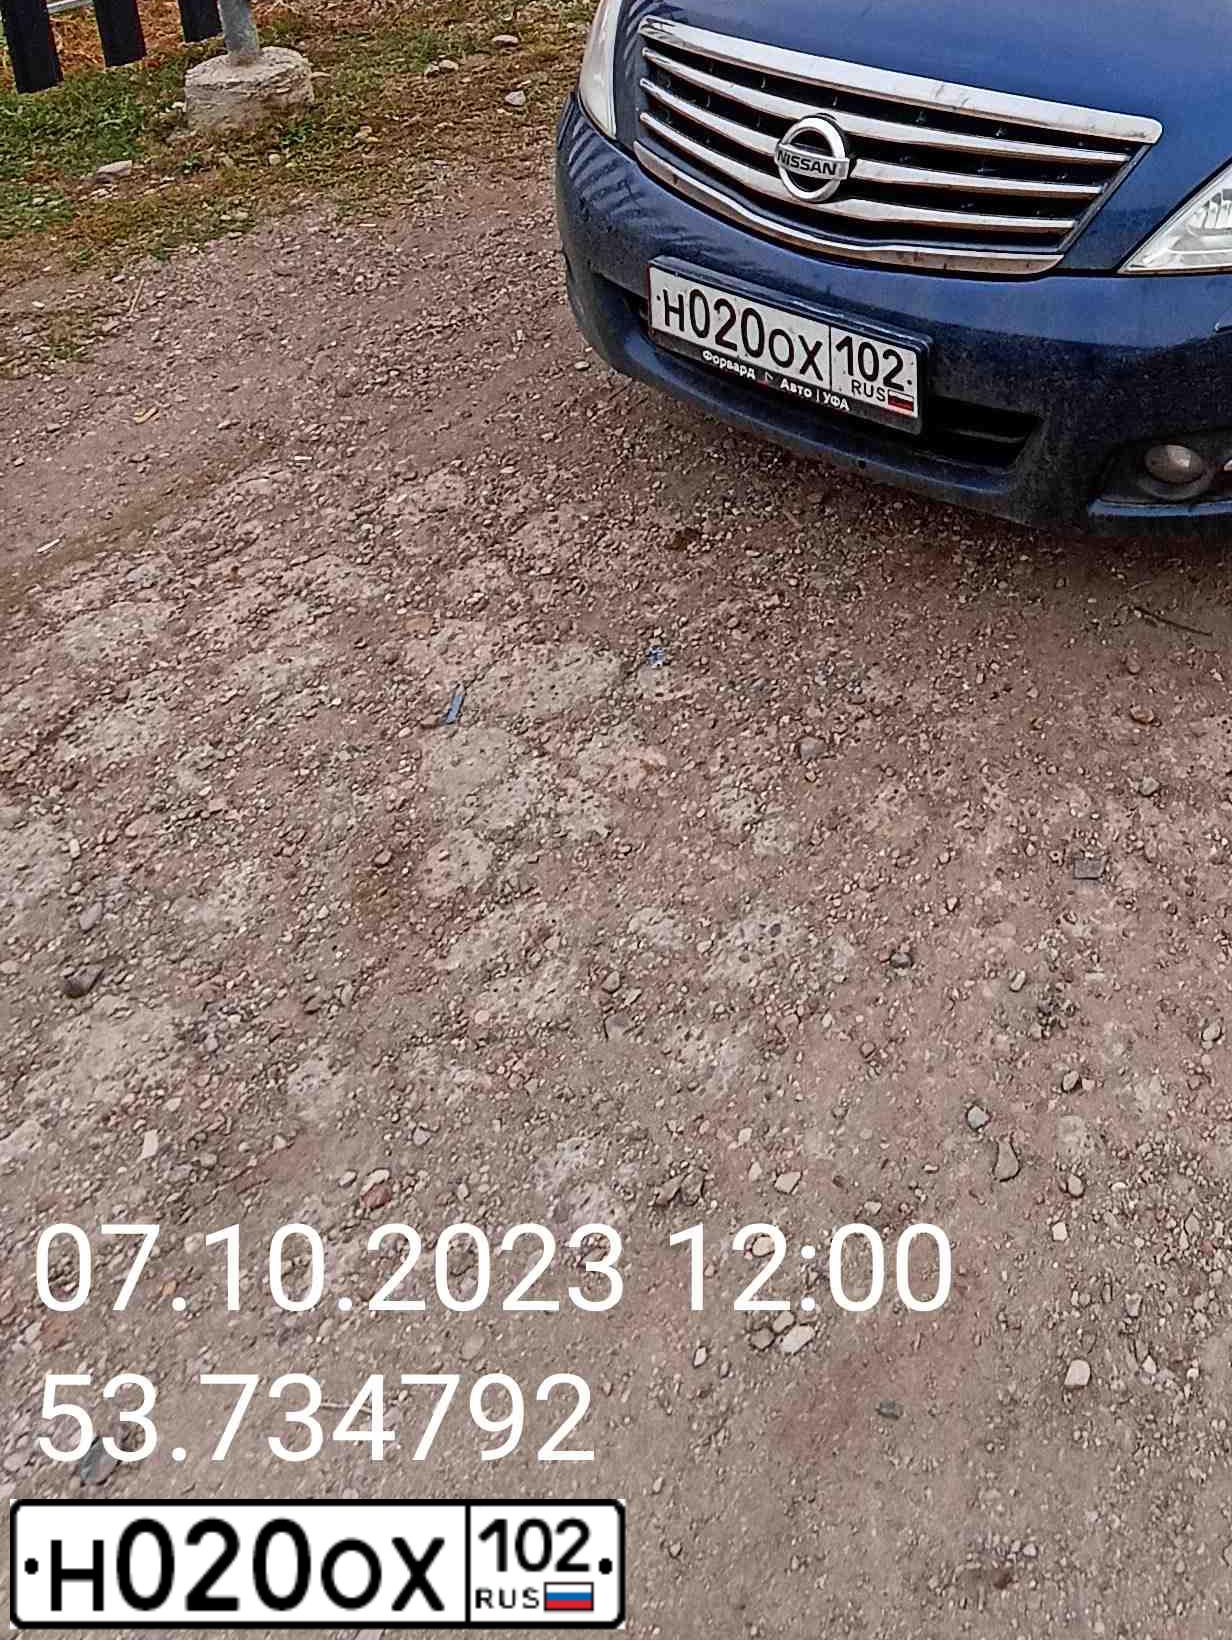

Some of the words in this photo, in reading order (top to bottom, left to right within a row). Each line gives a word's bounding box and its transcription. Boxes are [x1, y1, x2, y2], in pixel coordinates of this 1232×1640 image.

[777, 150, 837, 176] NISSAN
[835, 336, 905, 391] 102
[780, 377, 812, 399] Авто
[823, 391, 850, 410] УФА
[850, 378, 887, 401] RUS
